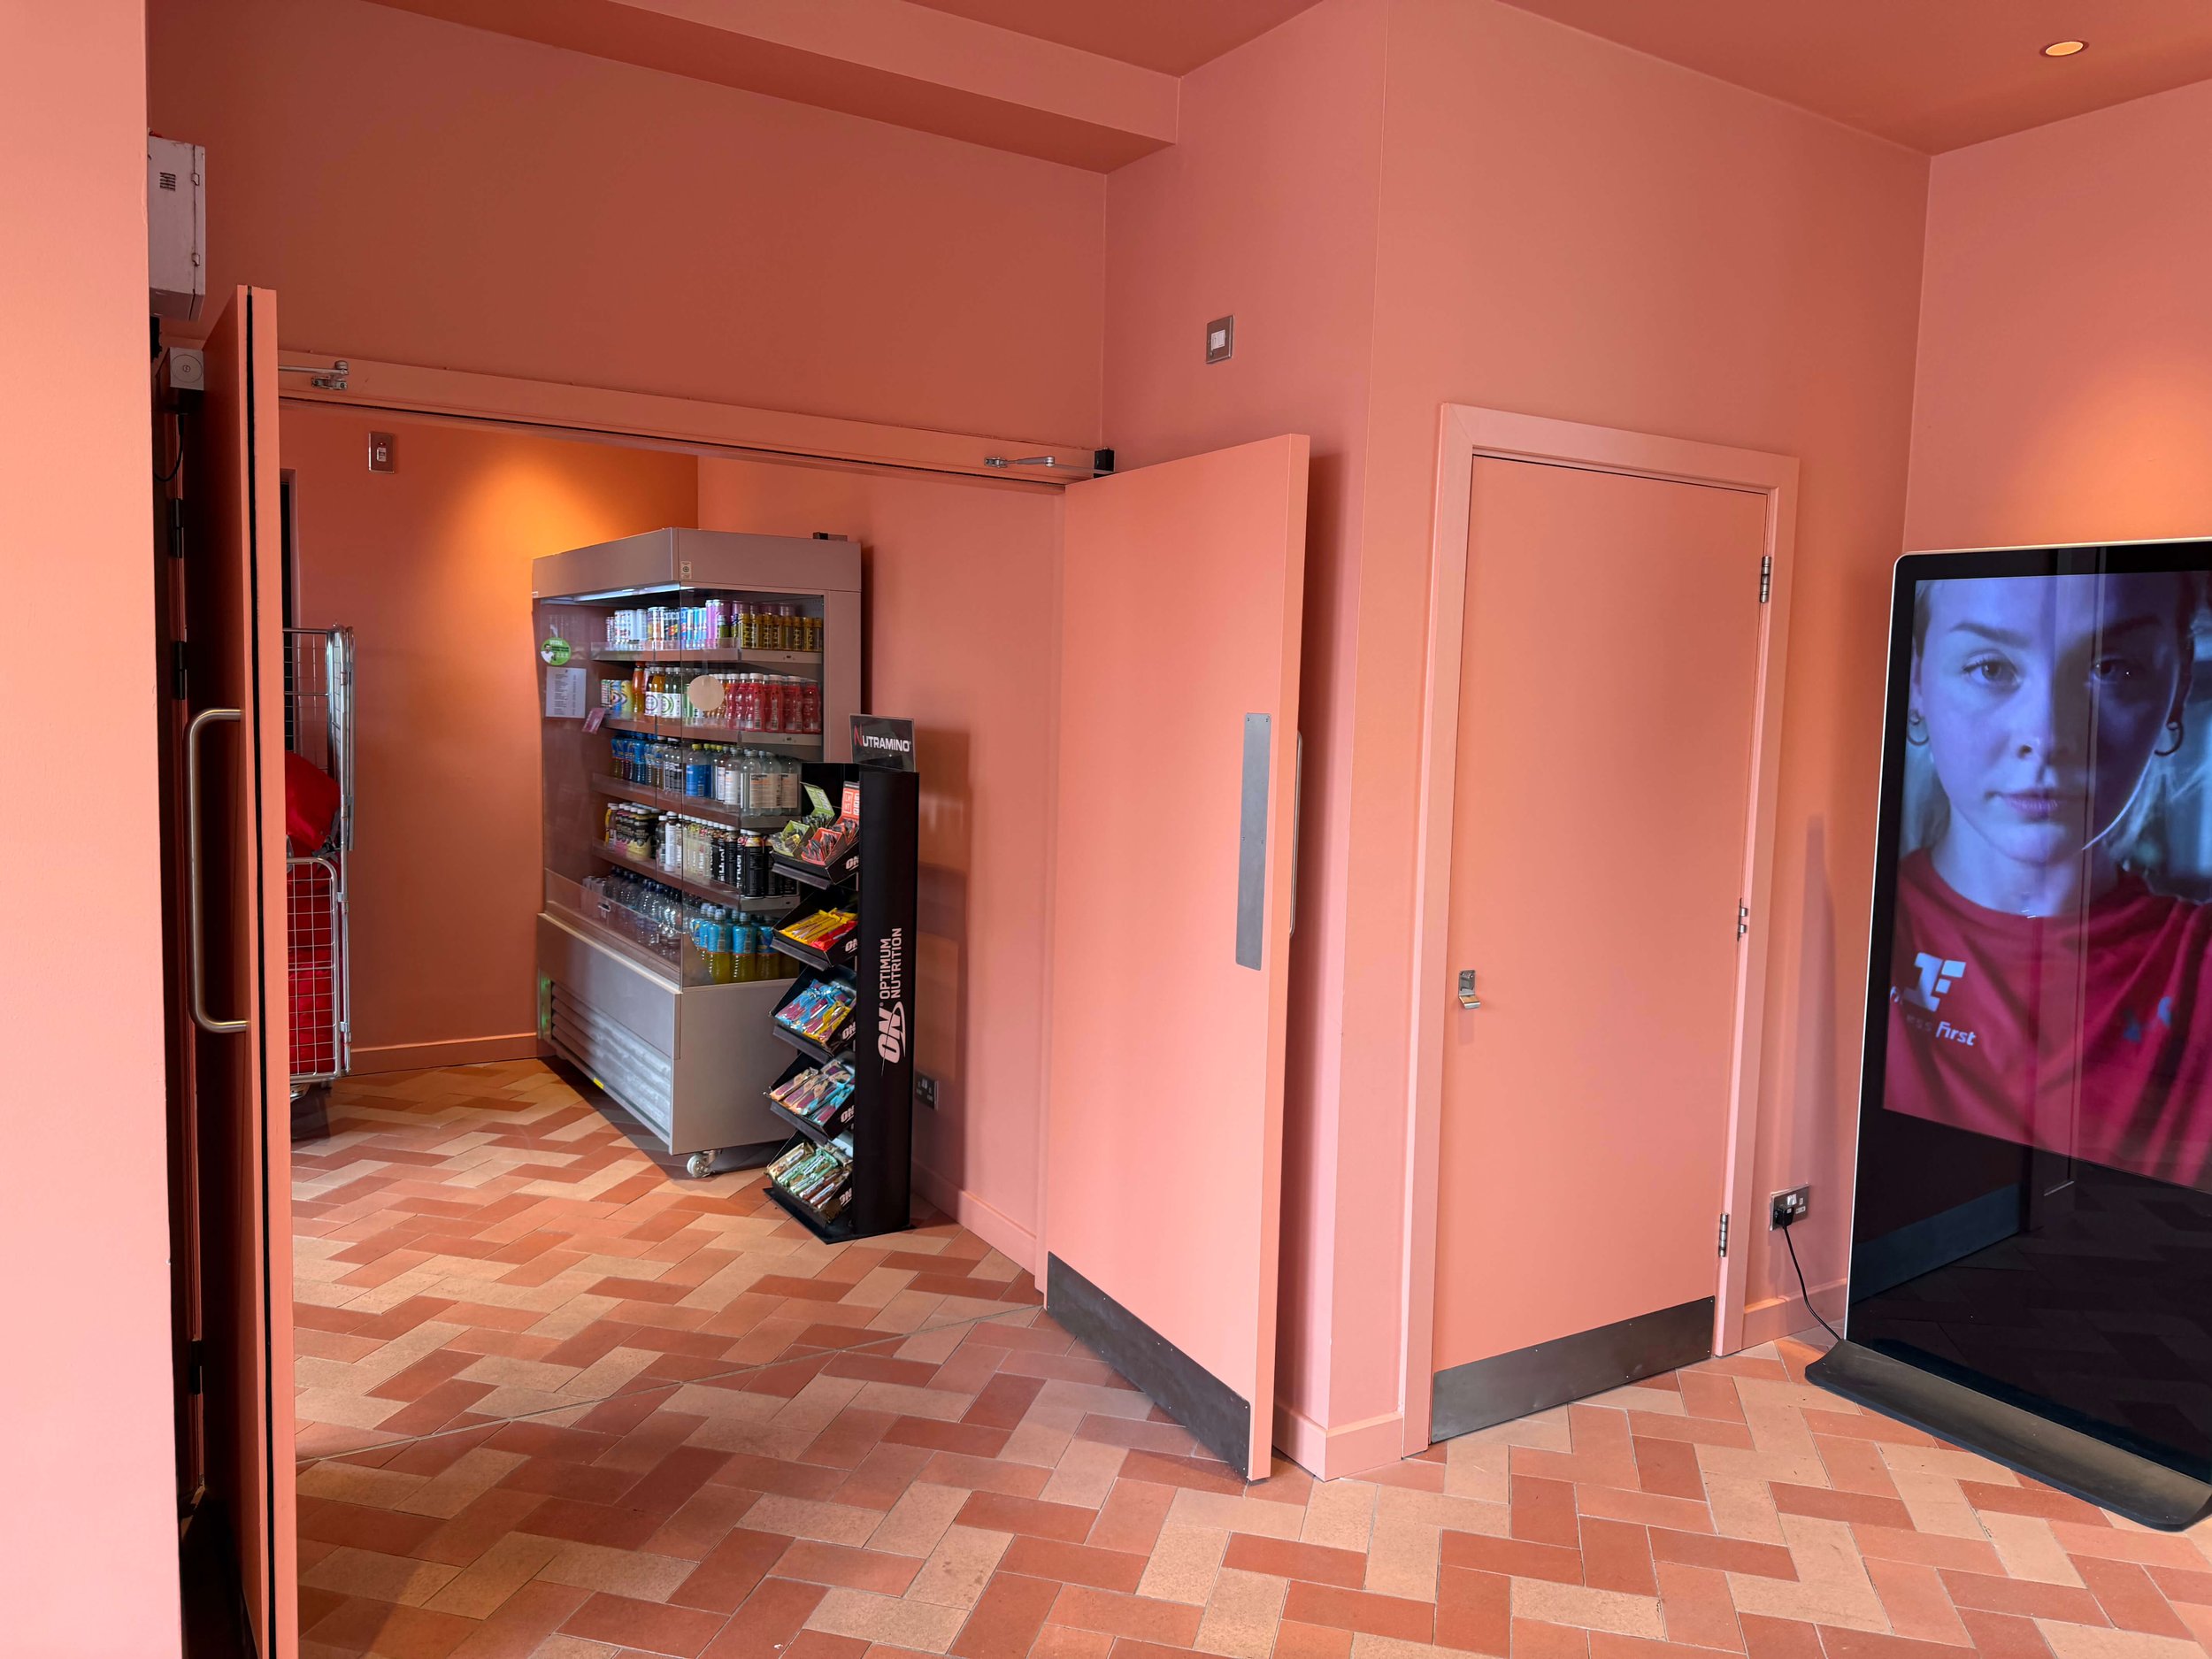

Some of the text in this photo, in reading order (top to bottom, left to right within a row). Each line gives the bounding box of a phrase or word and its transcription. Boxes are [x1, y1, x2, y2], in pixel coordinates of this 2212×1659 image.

[854, 722, 910, 752] NUTRAMINO
[879, 938, 891, 1000] OPTIMUM
[891, 927, 902, 999] NUTRITION
[1935, 1021, 1977, 1046] First
